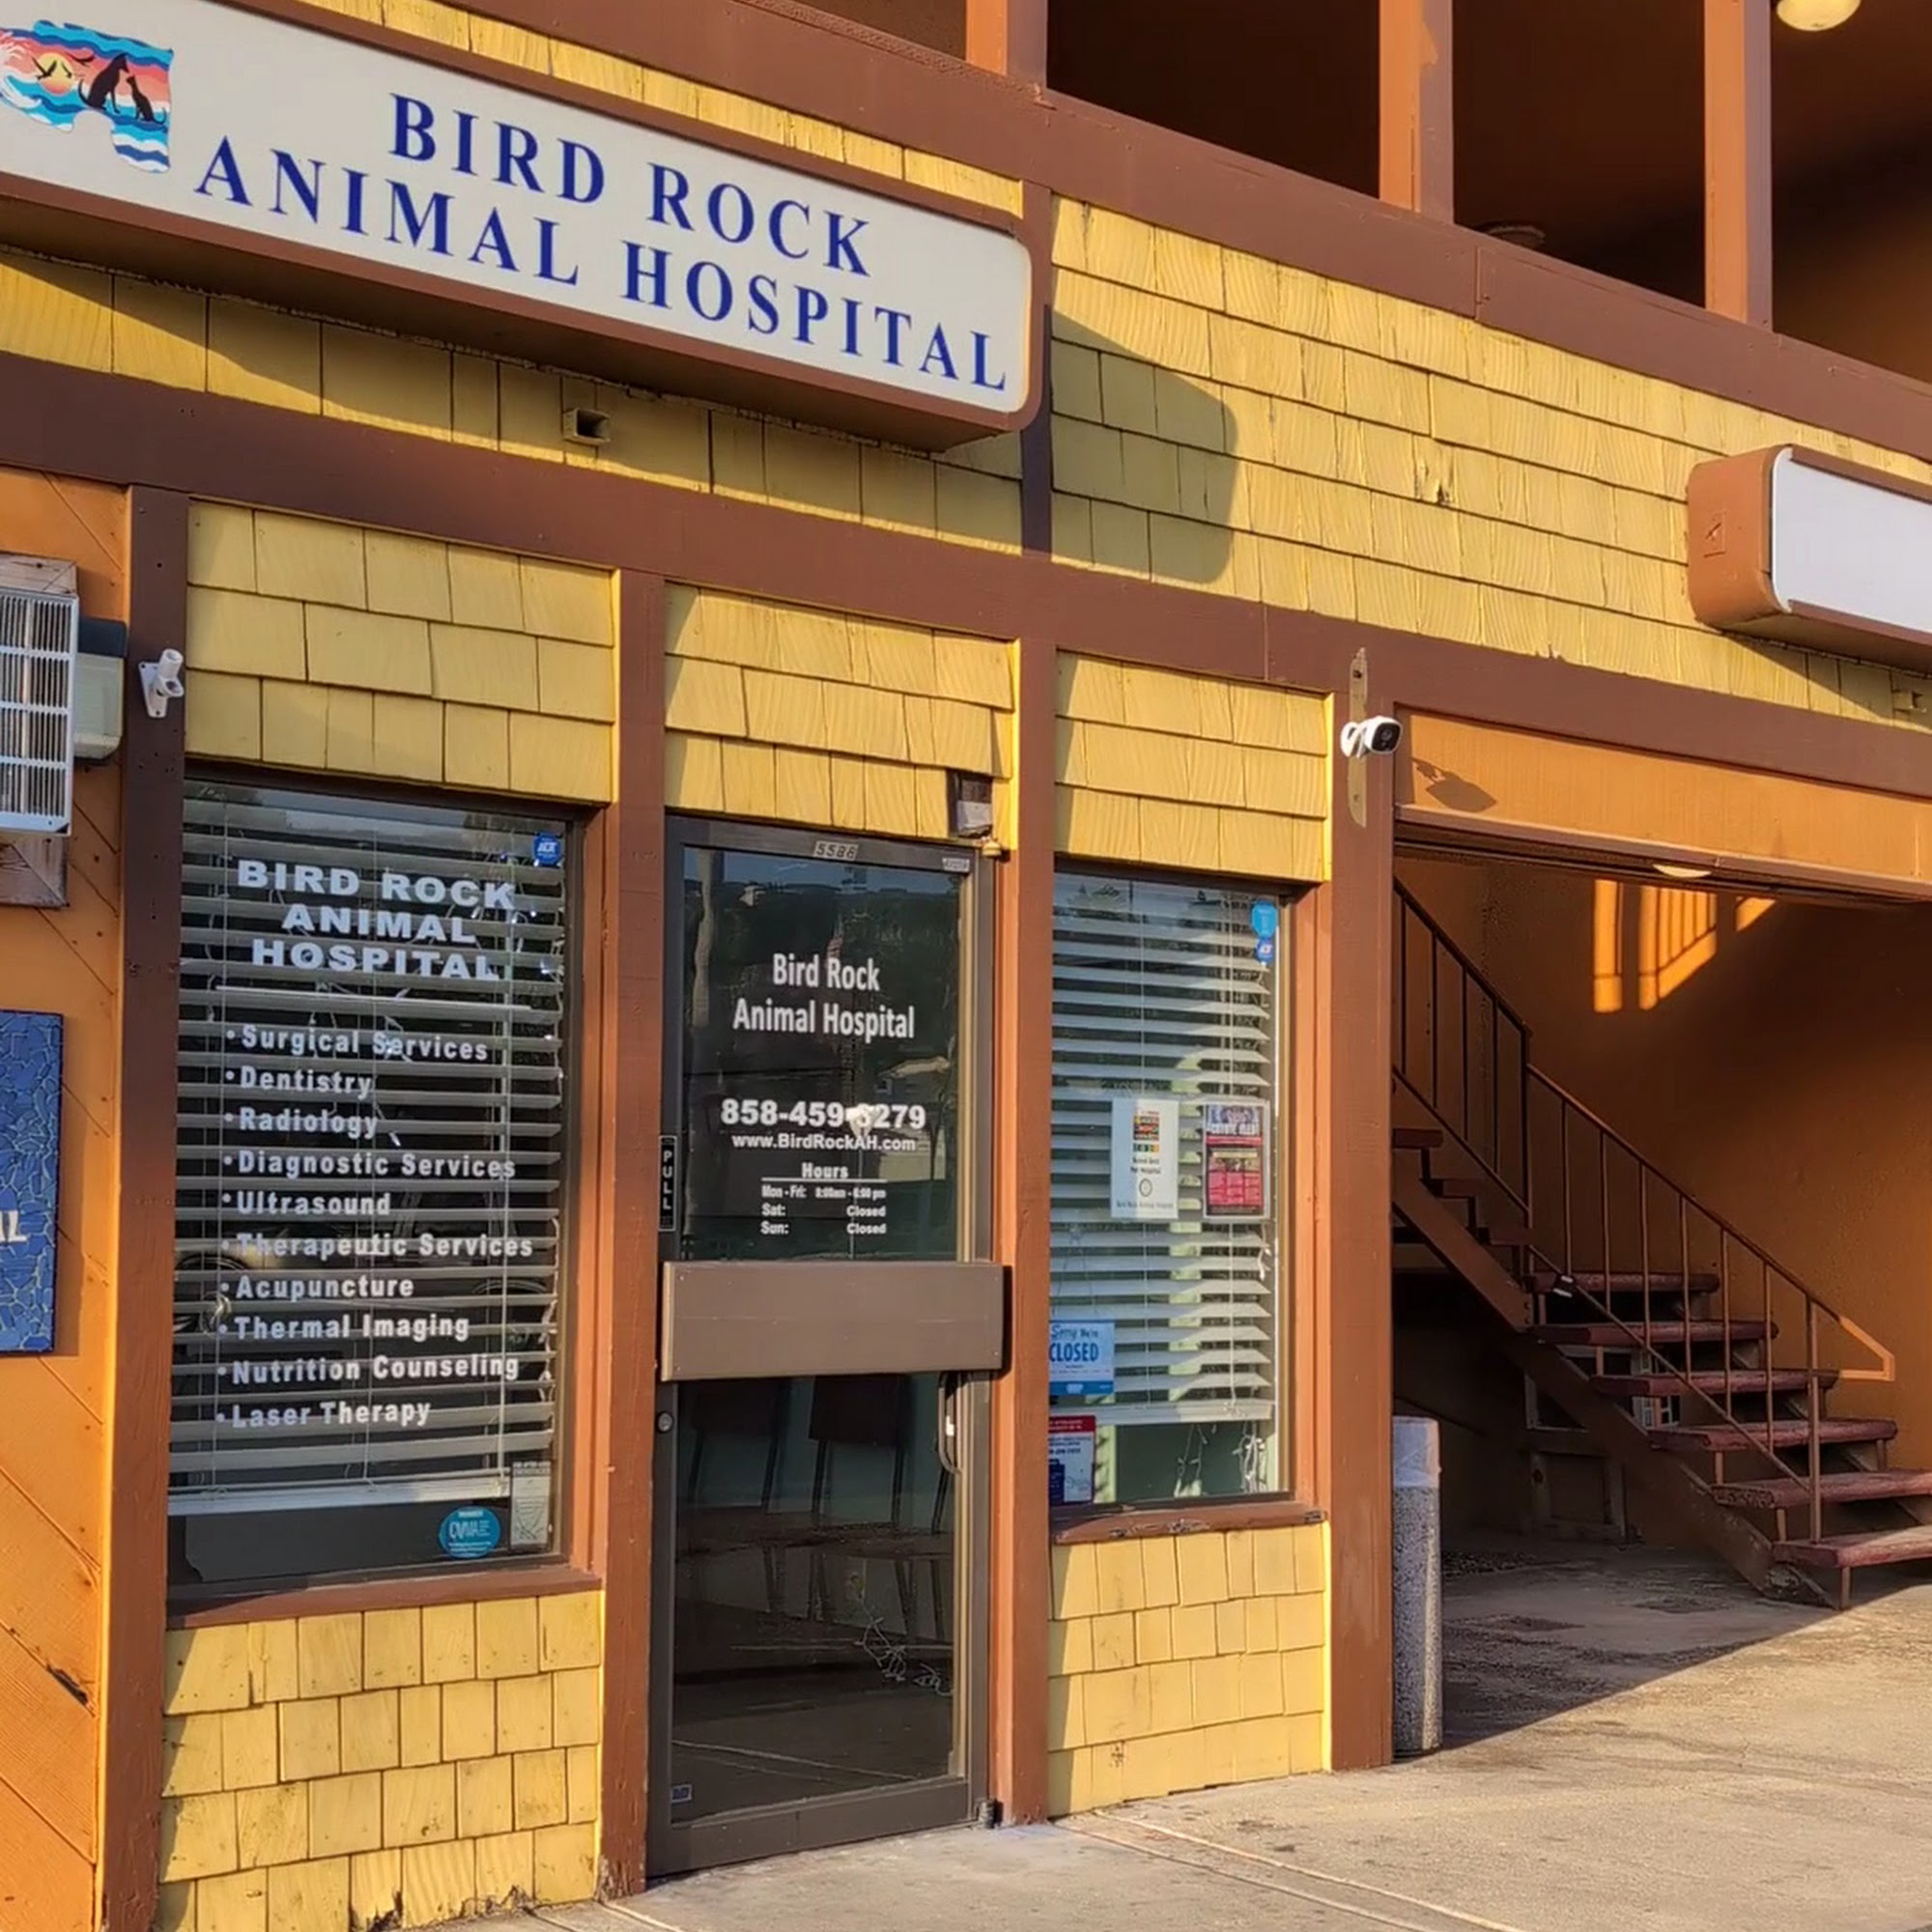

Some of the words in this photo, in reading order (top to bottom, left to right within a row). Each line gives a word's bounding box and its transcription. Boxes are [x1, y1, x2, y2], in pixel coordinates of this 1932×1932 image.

[390, 93, 605, 205] BIRD
[649, 162, 871, 278] ROCK
[196, 136, 578, 287] ANIMAL
[620, 242, 1007, 392] HOSPITAL
[238, 859, 360, 896] BIRD
[382, 871, 515, 911] ROCK
[282, 904, 475, 944] ANIMAL
[252, 939, 500, 981] HOSPITAL
[773, 952, 820, 988] Bird
[826, 956, 880, 992] Rock
[732, 997, 815, 1034] Animal
[822, 1002, 915, 1043] Hospital
[242, 1024, 359, 1059] Surgical
[372, 1031, 488, 1061] Services
[240, 1066, 373, 1100] Dentistry
[239, 1107, 378, 1140] Radiology
[731, 1133, 916, 1151] www.BirdRockAH.com
[239, 1151, 388, 1179] Diagnostic
[402, 1153, 516, 1179] Services
[663, 1150, 672, 1210] PULL
[802, 1162, 849, 1179] Hours
[237, 1191, 391, 1216] Ultrasound
[761, 1202, 786, 1216] Sat:
[846, 1205, 887, 1217] Closed
[760, 1220, 789, 1235] Sun:
[846, 1222, 887, 1235] Closed
[237, 1234, 406, 1261] Therapeutic
[419, 1234, 532, 1257] Services
[236, 1276, 413, 1303] Acupuncture
[235, 1315, 350, 1340] Thermal
[362, 1314, 469, 1343] Imaging
[1049, 1342, 1099, 1362] CLOSED
[232, 1357, 359, 1385] Nutrition
[373, 1353, 520, 1381] Counseling
[232, 1406, 311, 1430] Laser
[320, 1400, 431, 1427] Therapy
